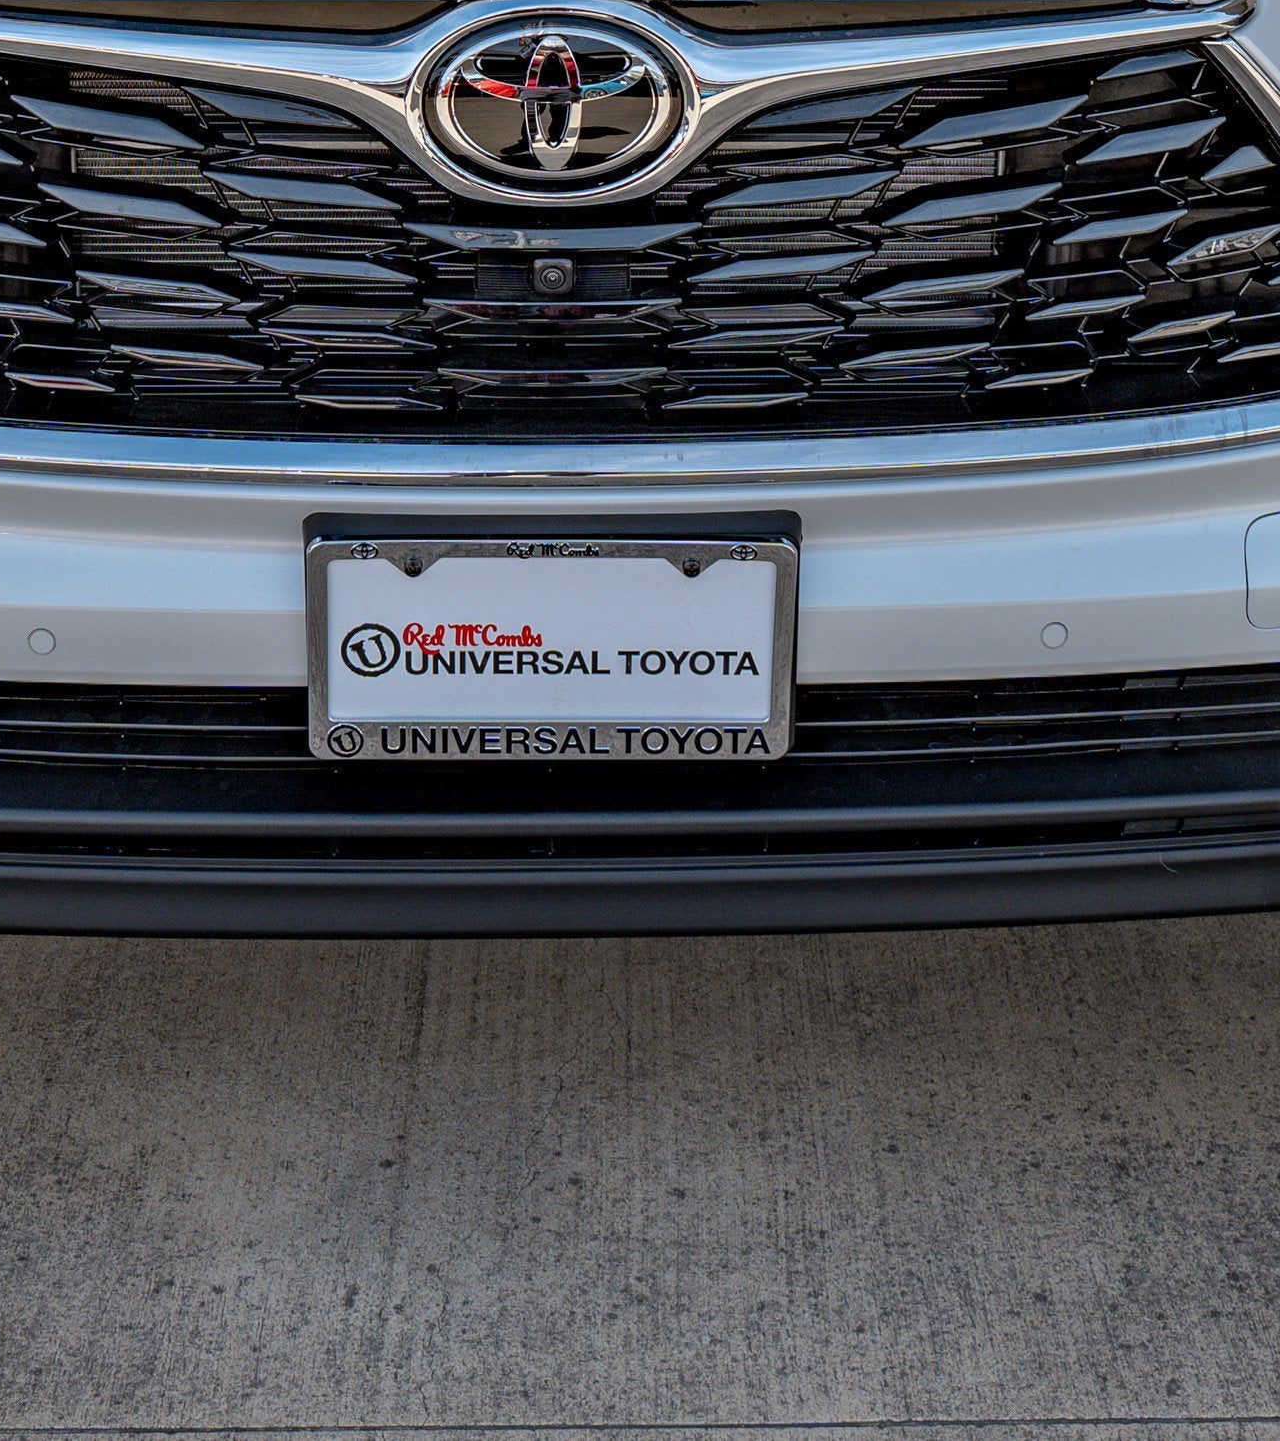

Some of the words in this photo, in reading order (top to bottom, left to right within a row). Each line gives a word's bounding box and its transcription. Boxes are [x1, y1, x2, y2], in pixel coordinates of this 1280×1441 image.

[506, 541, 535, 559] Red
[402, 623, 445, 655] Red
[448, 623, 543, 647] McCombs
[405, 650, 610, 675] UNIVERSAL
[618, 650, 760, 675] TOYOTA
[380, 726, 610, 755] UNIVERSAL
[616, 726, 771, 755] TOYOTA
